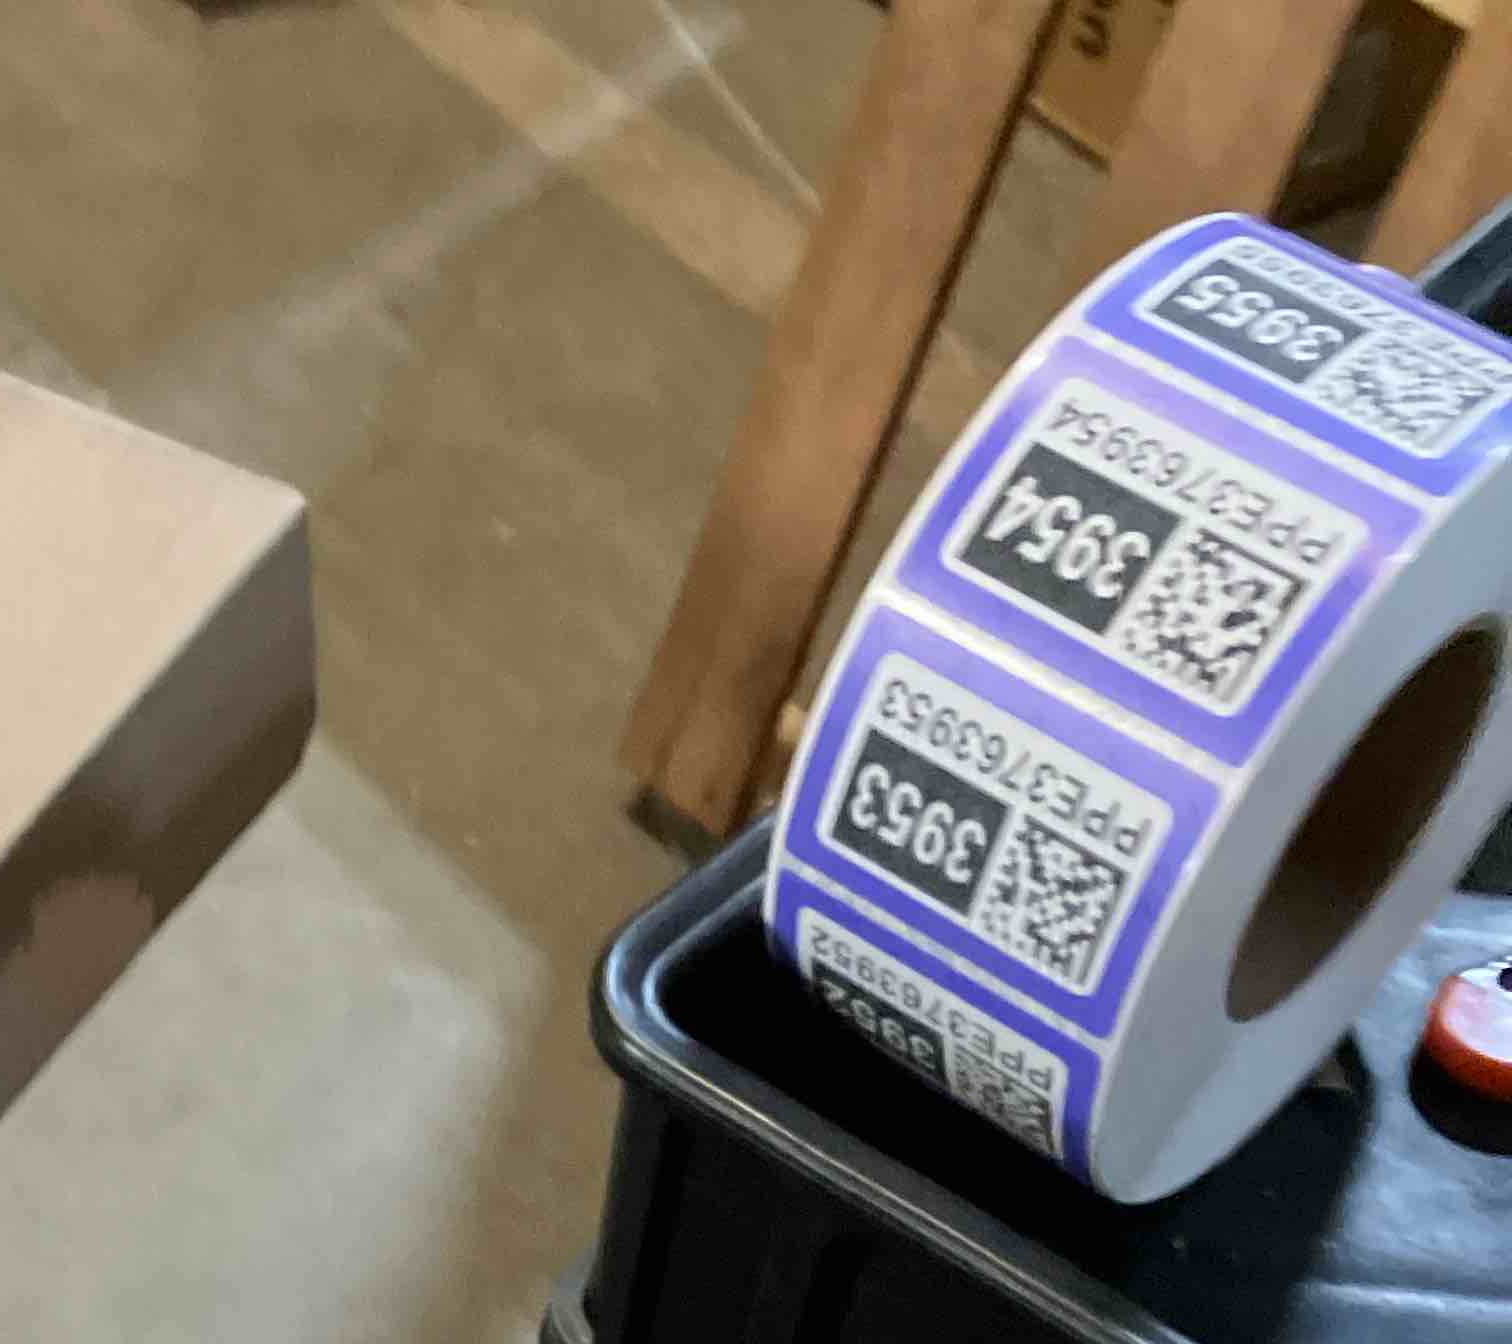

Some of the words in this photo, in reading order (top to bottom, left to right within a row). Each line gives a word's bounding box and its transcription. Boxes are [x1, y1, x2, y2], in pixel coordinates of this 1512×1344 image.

[1172, 274, 1345, 362] 3955
[985, 475, 1152, 600] 3954
[1047, 397, 1346, 567] PPE3763954
[849, 762, 987, 885] 3953
[879, 678, 1153, 858] PPE3763953
[809, 924, 1053, 1093] PPE3763952
